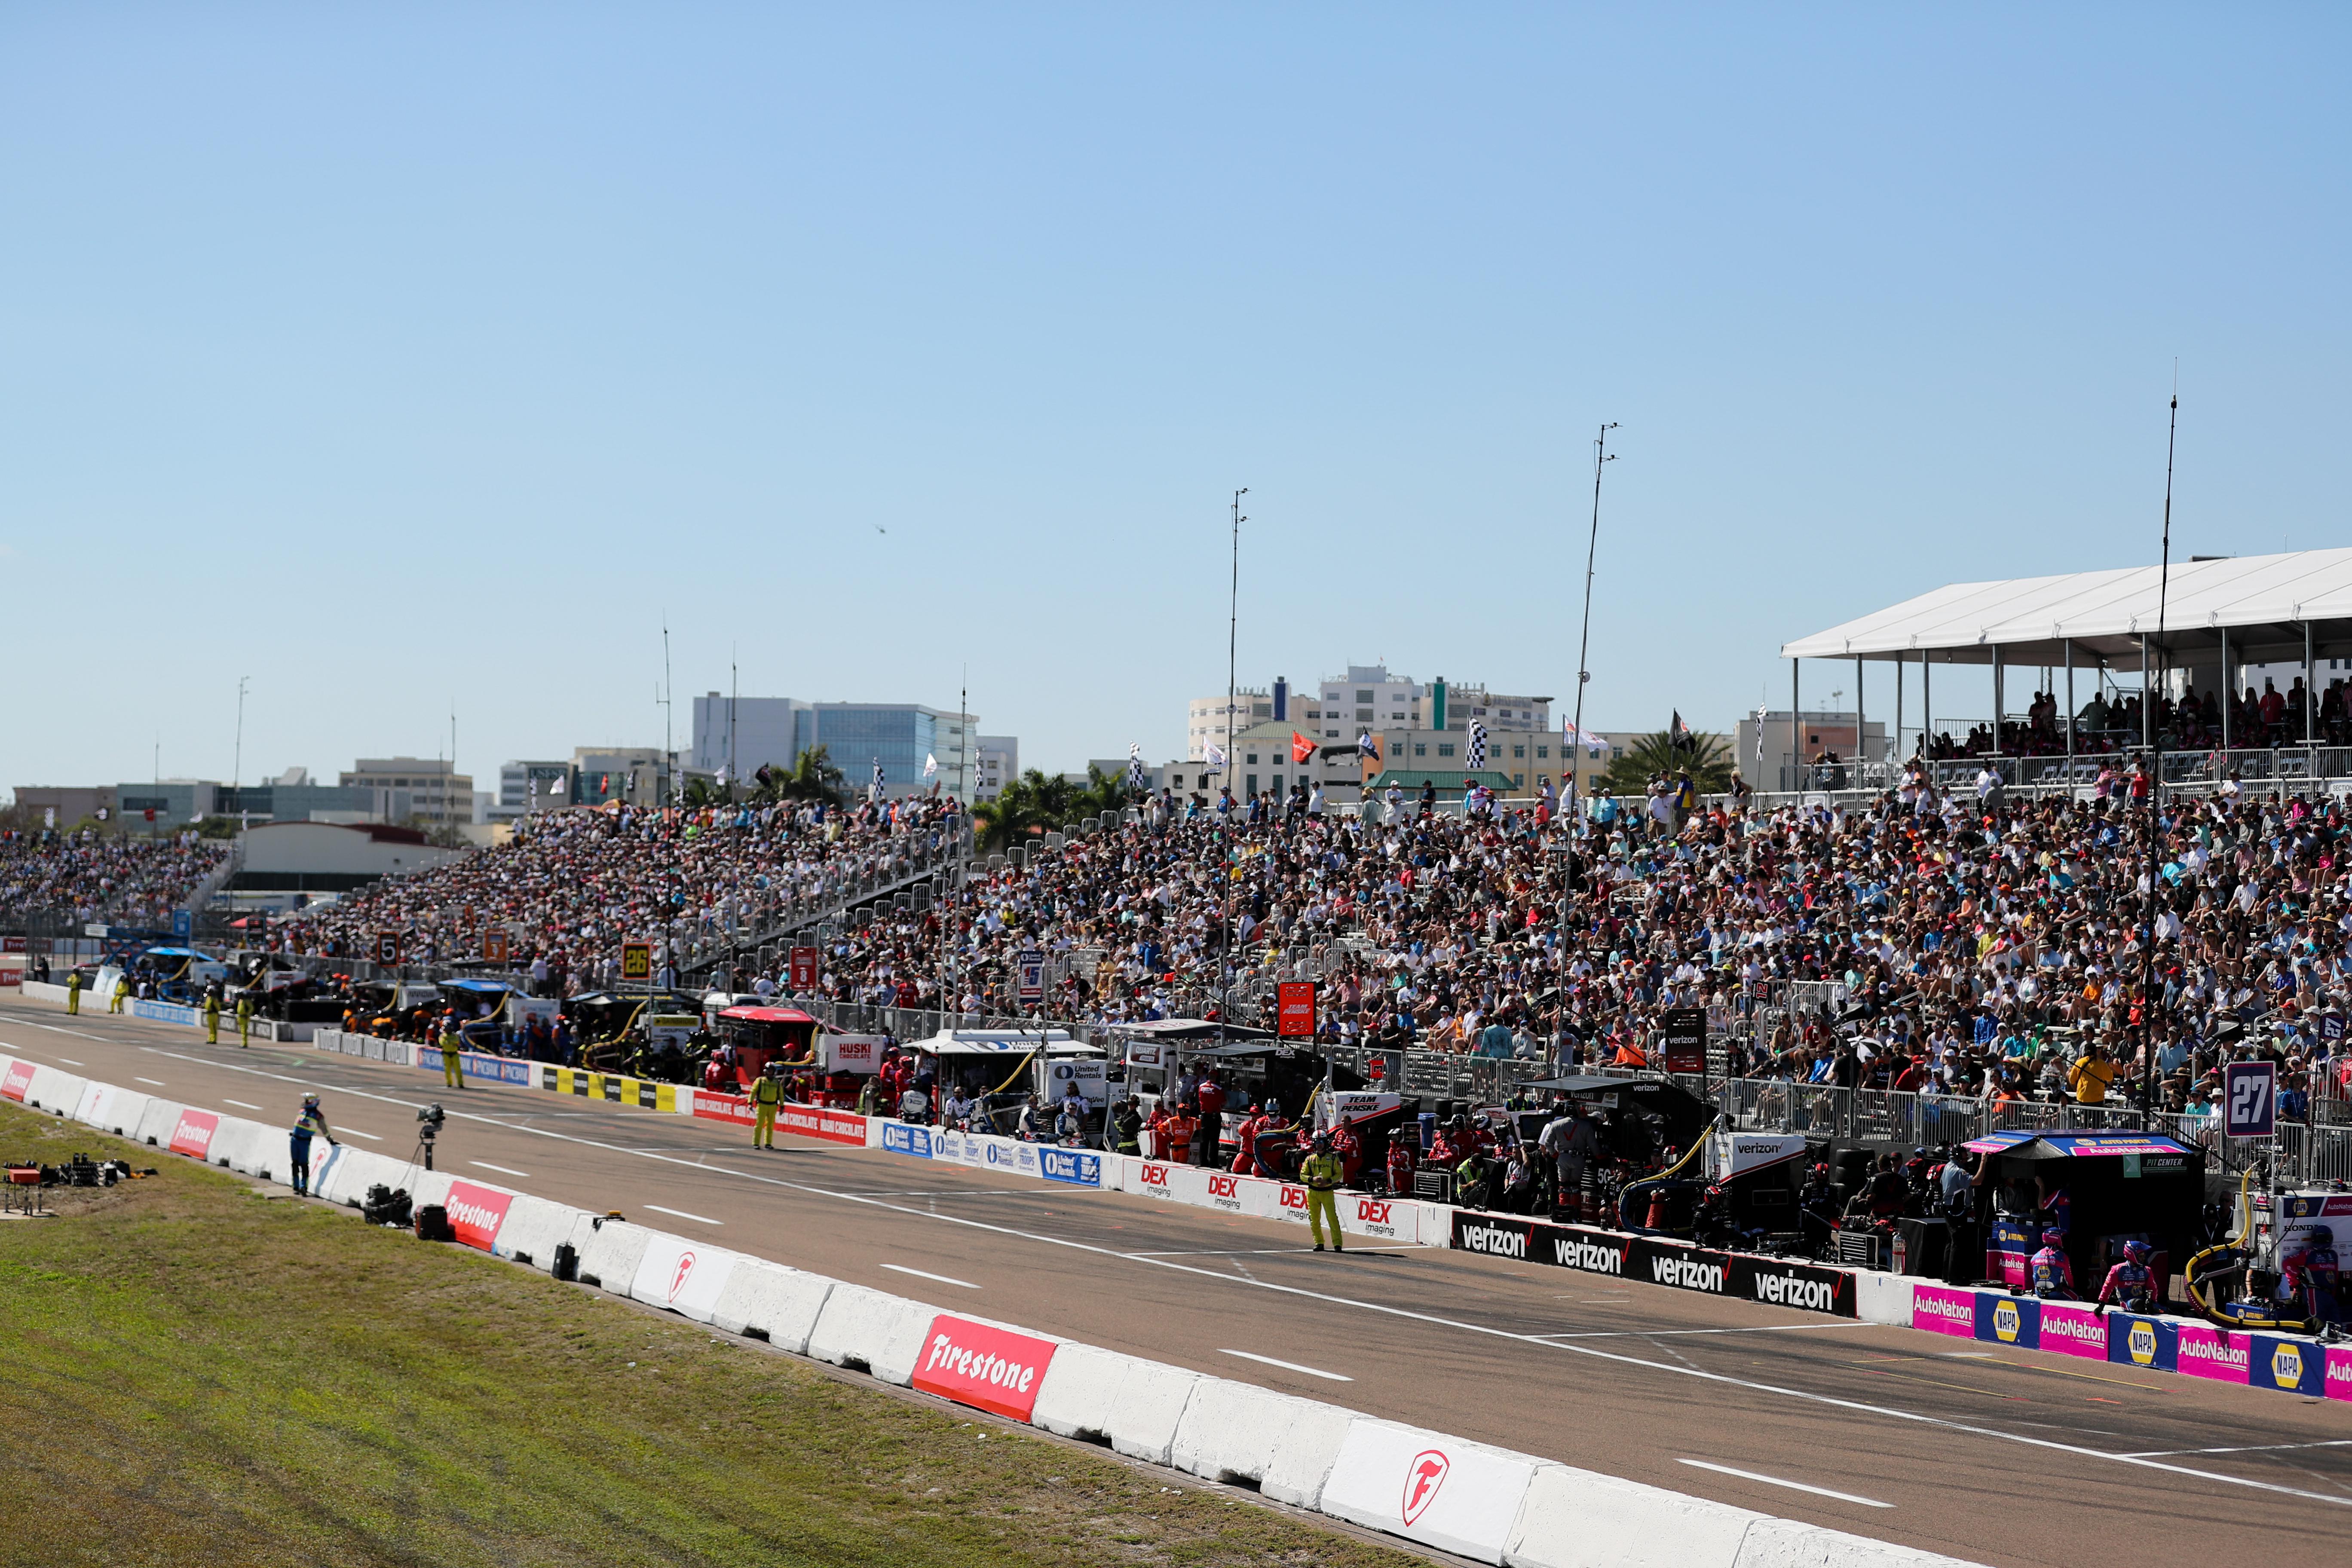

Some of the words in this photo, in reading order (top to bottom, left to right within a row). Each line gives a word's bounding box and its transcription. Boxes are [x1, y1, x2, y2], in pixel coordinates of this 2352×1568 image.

[381, 939, 395, 961] 5
[626, 949, 647, 973] 26
[800, 970, 807, 982] 8
[1023, 966, 1040, 986] 15
[1756, 982, 1768, 999] 12
[2324, 1017, 2342, 1039] 27
[839, 1043, 871, 1054] HUSKI
[1669, 1035, 1697, 1044] verizon
[1136, 1046, 1156, 1055] QUARTZ
[3, 1069, 29, 1090] Firestone
[694, 1097, 706, 1111] HUSKI
[707, 1099, 732, 1115] CHOCOLATE
[2231, 1075, 2270, 1124] 27
[775, 1112, 789, 1124] HUSKI
[789, 1112, 818, 1130] CHOCOLATE
[820, 1118, 834, 1133] HUSKI
[835, 1120, 865, 1138] CHOCOLATE
[175, 1119, 211, 1145] Firestone
[945, 1137, 958, 1147] United
[945, 1147, 959, 1157] Rentals
[965, 1146, 979, 1157] TROOPS
[998, 1145, 1011, 1156] United
[1738, 1142, 1779, 1153] verizon
[998, 1156, 1014, 1167] Rentals
[1019, 1154, 1035, 1166] TROOPS
[1058, 1155, 1075, 1166] United
[1057, 1166, 1075, 1177] Rentals
[1141, 1164, 1169, 1186] DEX
[1147, 1184, 1171, 1197] imaging
[1208, 1176, 1238, 1198] DEX
[1215, 1196, 1240, 1210] imaging
[1280, 1187, 1308, 1210] DEX
[447, 1194, 499, 1231] Firestone
[1287, 1208, 1310, 1220] imagin
[1358, 1200, 1392, 1224] DEX
[1365, 1222, 1394, 1237] imaging
[1462, 1221, 1525, 1258] verizon
[1555, 1236, 1621, 1274] verizon
[1652, 1253, 1722, 1292] verizon
[1755, 1269, 1832, 1311] verizon
[1914, 1294, 1972, 1320] AutoNation
[1997, 1311, 2016, 1331] NAPA
[2041, 1315, 2106, 1342] AutoNation
[2132, 1332, 2153, 1354] NAPA
[2178, 1337, 2248, 1365] AutoNation
[925, 1333, 1034, 1393] Firestone
[2276, 1354, 2299, 1377] NAPA
